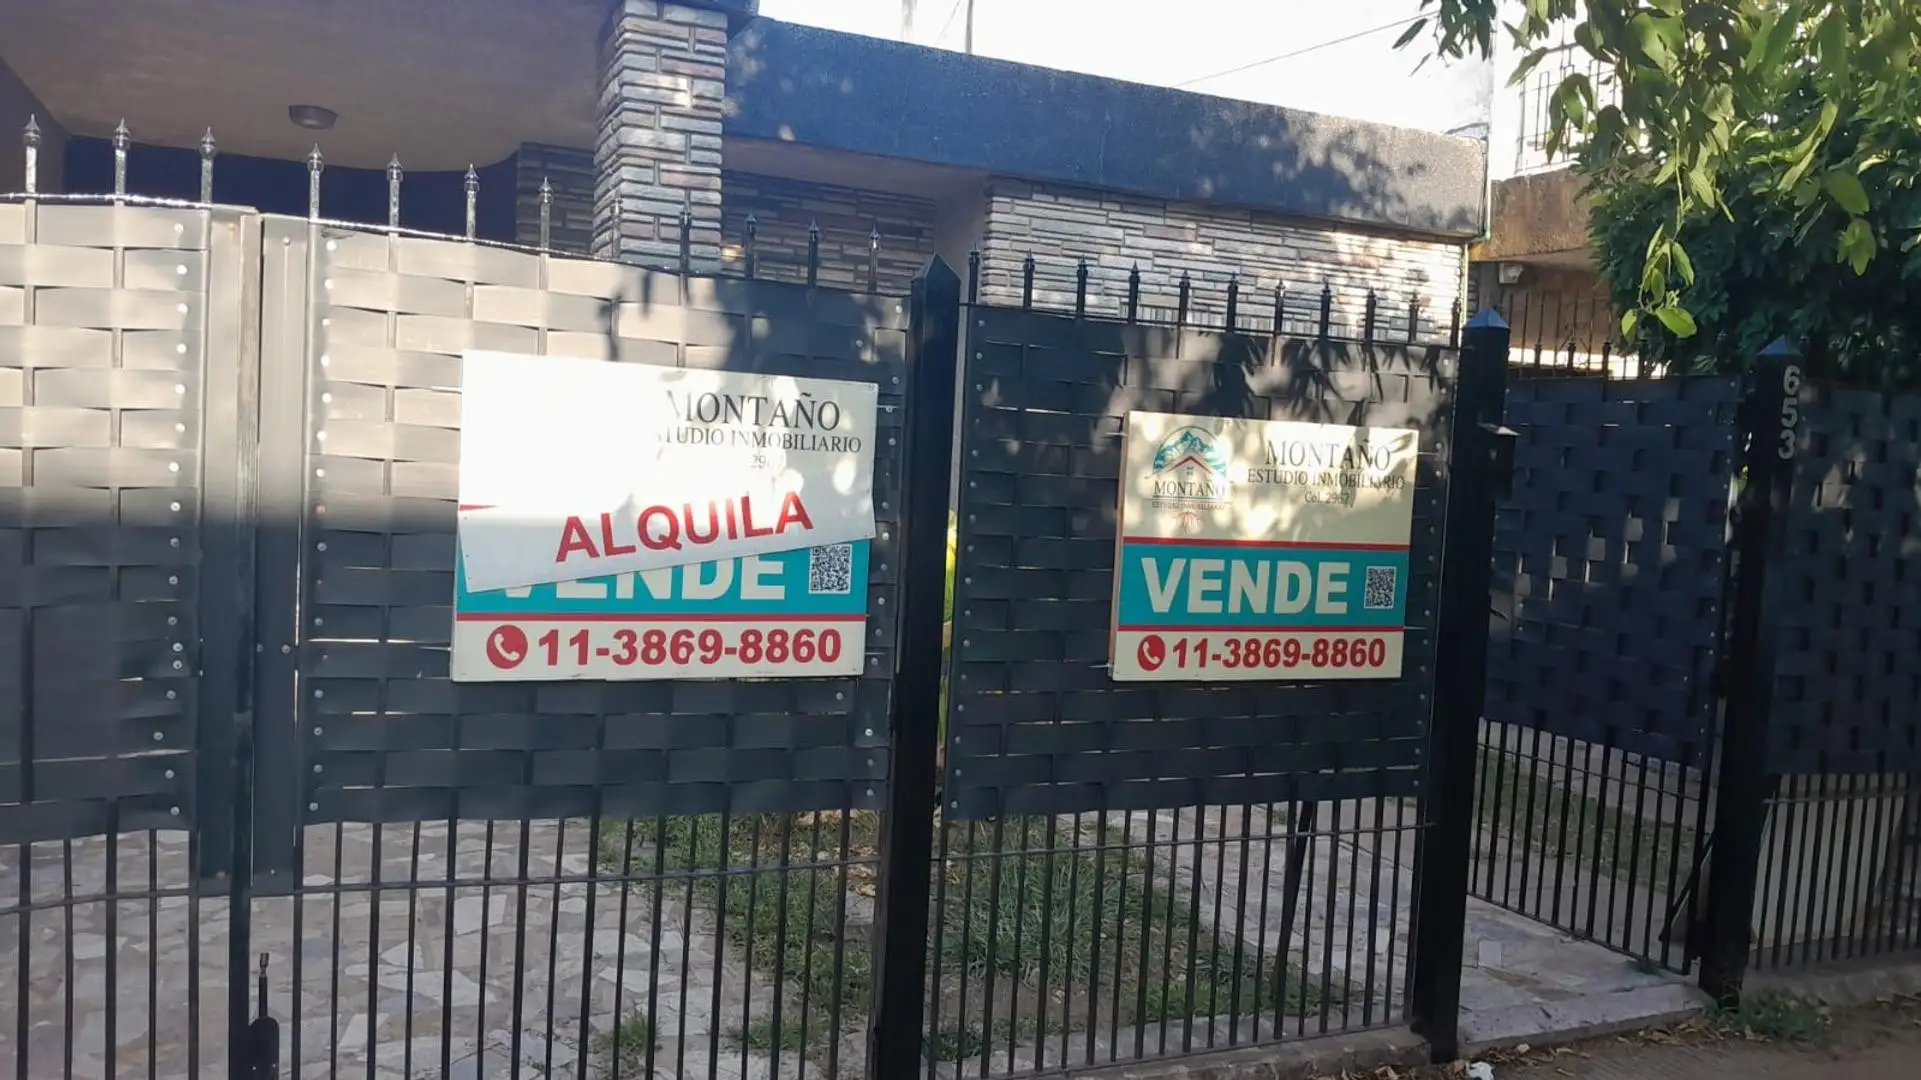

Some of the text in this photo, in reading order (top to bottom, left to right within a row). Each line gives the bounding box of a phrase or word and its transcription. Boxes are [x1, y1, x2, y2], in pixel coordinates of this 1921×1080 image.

[1778, 365, 1801, 459] 653
[730, 430, 862, 453] INMOBILIARIO
[1265, 438, 1391, 471] MONTAÑO
[1248, 467, 1308, 486] ESTUDIO
[555, 491, 814, 563] ALQUILA
[1141, 557, 1351, 614] VENDE
[538, 628, 841, 667] 11-3869-8860
[1173, 638, 1386, 668] 11-3869-8860
